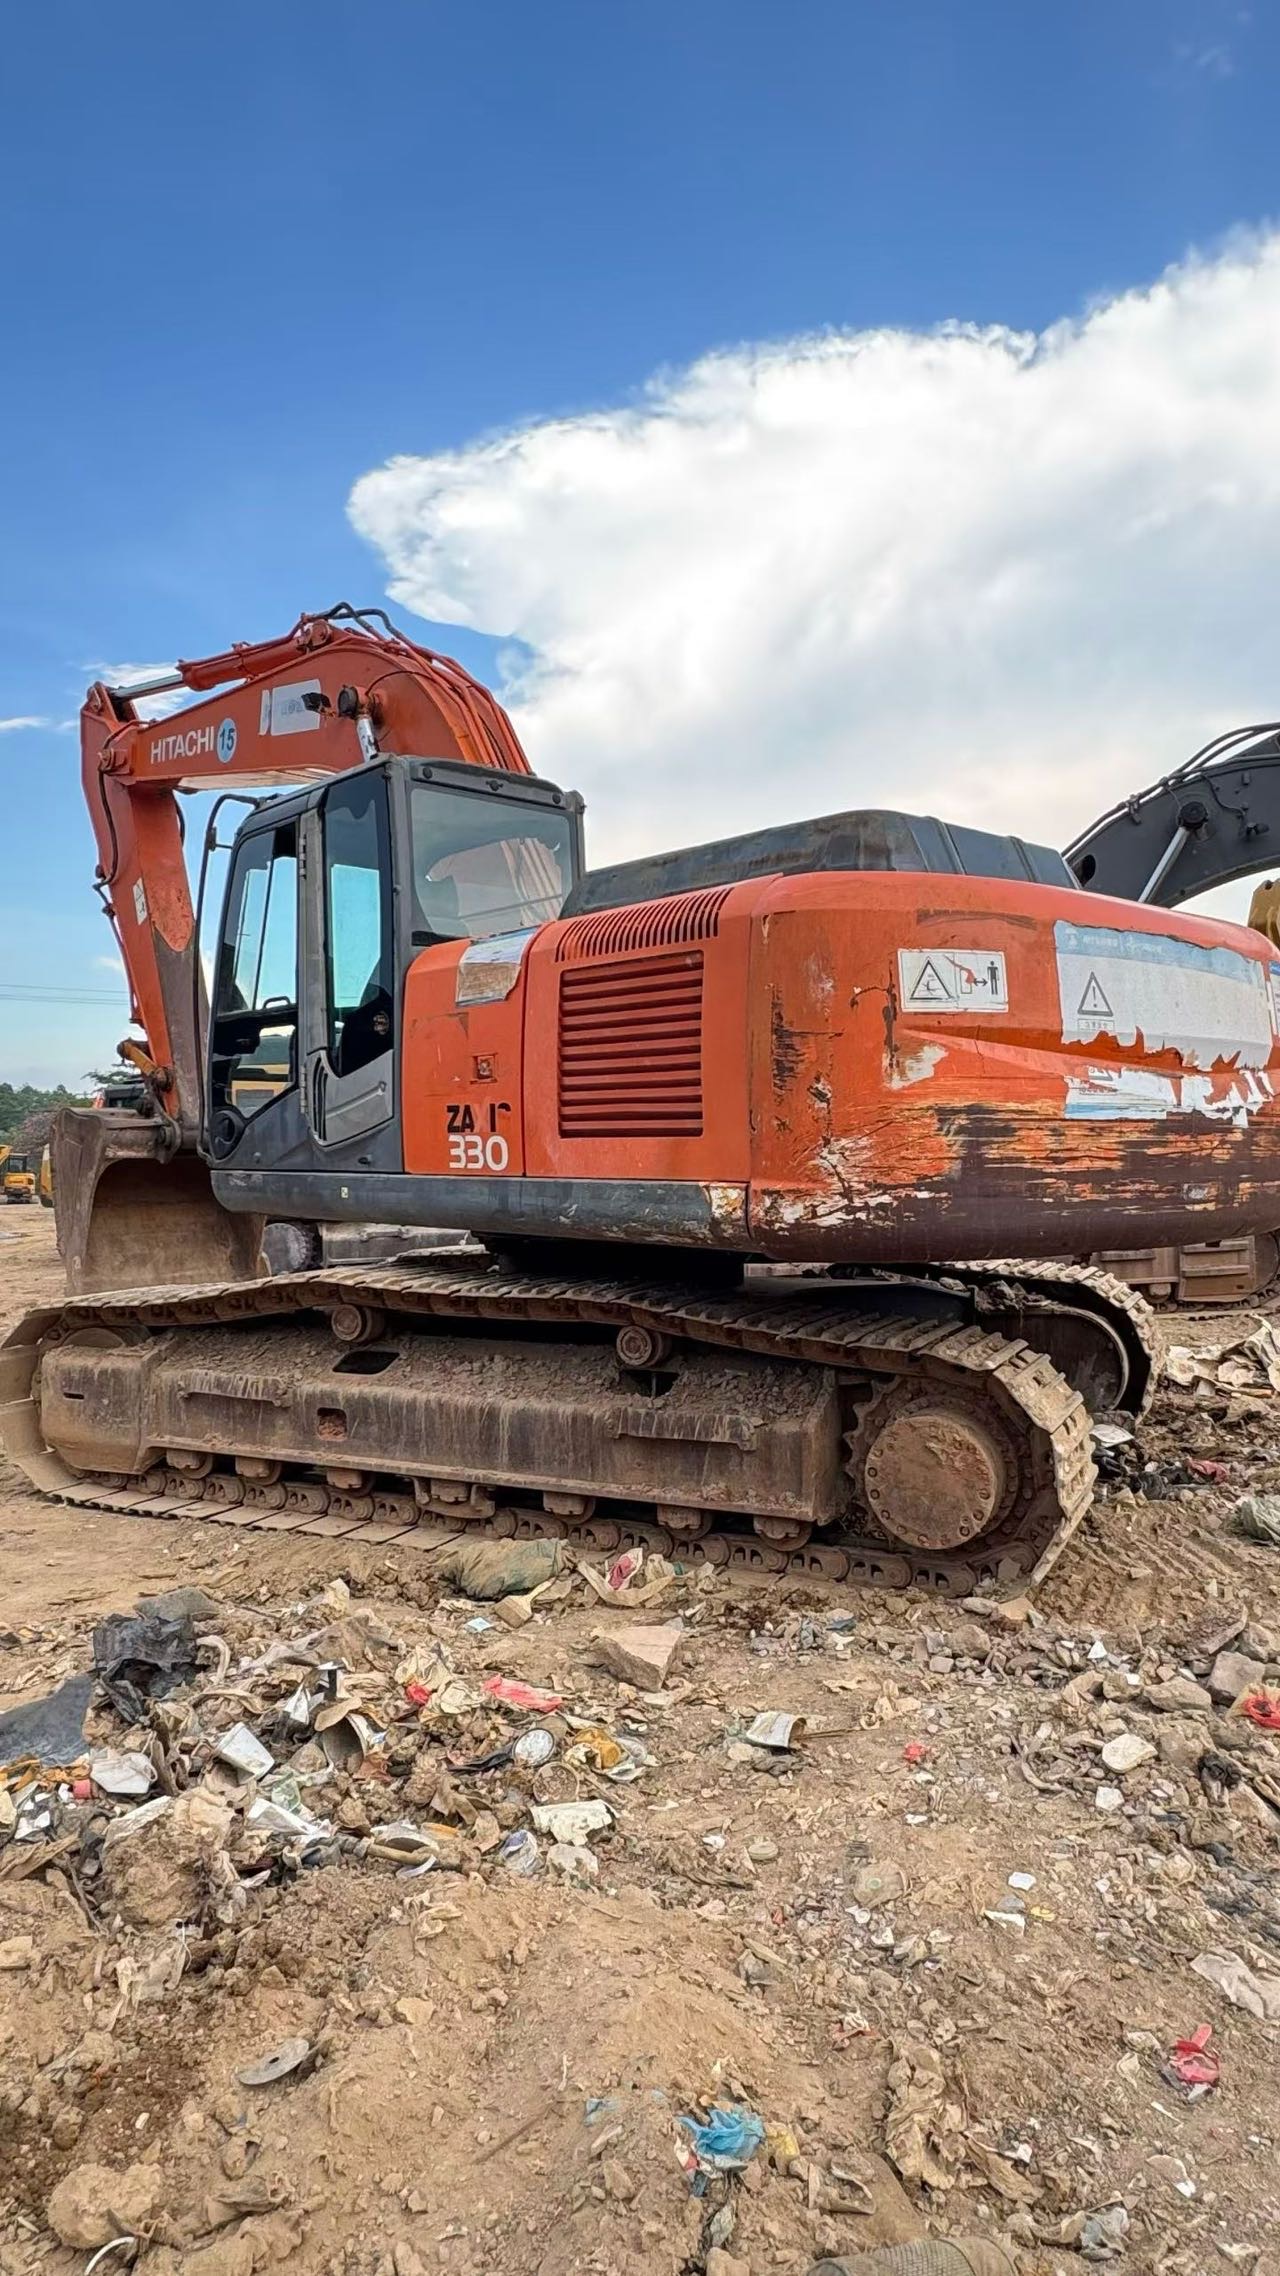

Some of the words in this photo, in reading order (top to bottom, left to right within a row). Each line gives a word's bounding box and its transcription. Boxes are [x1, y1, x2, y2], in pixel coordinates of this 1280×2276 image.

[150, 726, 215, 764] HITACHI
[219, 728, 235, 751] 15
[446, 1102, 512, 1133] ZAI
[448, 1134, 509, 1171] 330
